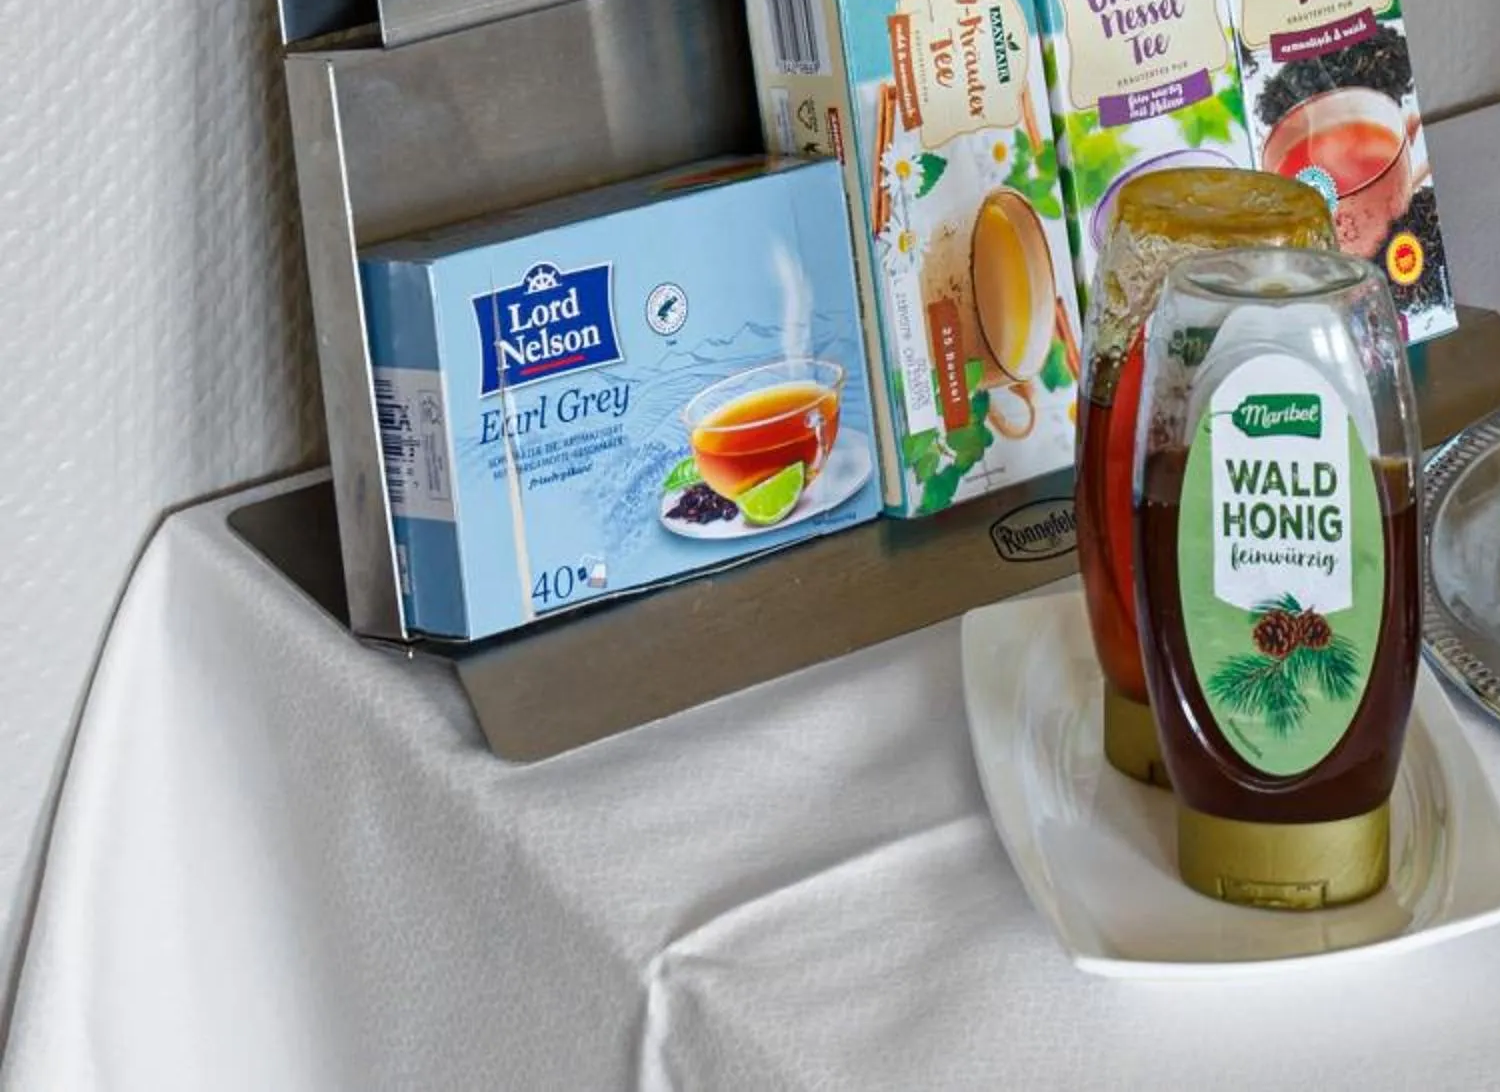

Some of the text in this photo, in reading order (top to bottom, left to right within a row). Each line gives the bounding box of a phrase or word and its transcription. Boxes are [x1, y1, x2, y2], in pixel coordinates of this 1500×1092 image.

[929, 28, 955, 89] Tee
[990, 7, 1011, 84] MAYFAIR
[1124, 32, 1171, 66] Tee
[508, 288, 581, 333] Lord
[496, 323, 602, 371] Nelson
[557, 384, 630, 424] Grey
[1240, 402, 1320, 428] Maribel
[1226, 459, 1338, 498] WALD
[995, 510, 1078, 555] Ronnefel
[1222, 501, 1343, 542] HONIG
[1231, 543, 1338, 577] feinwürzig
[532, 565, 575, 604] 40
